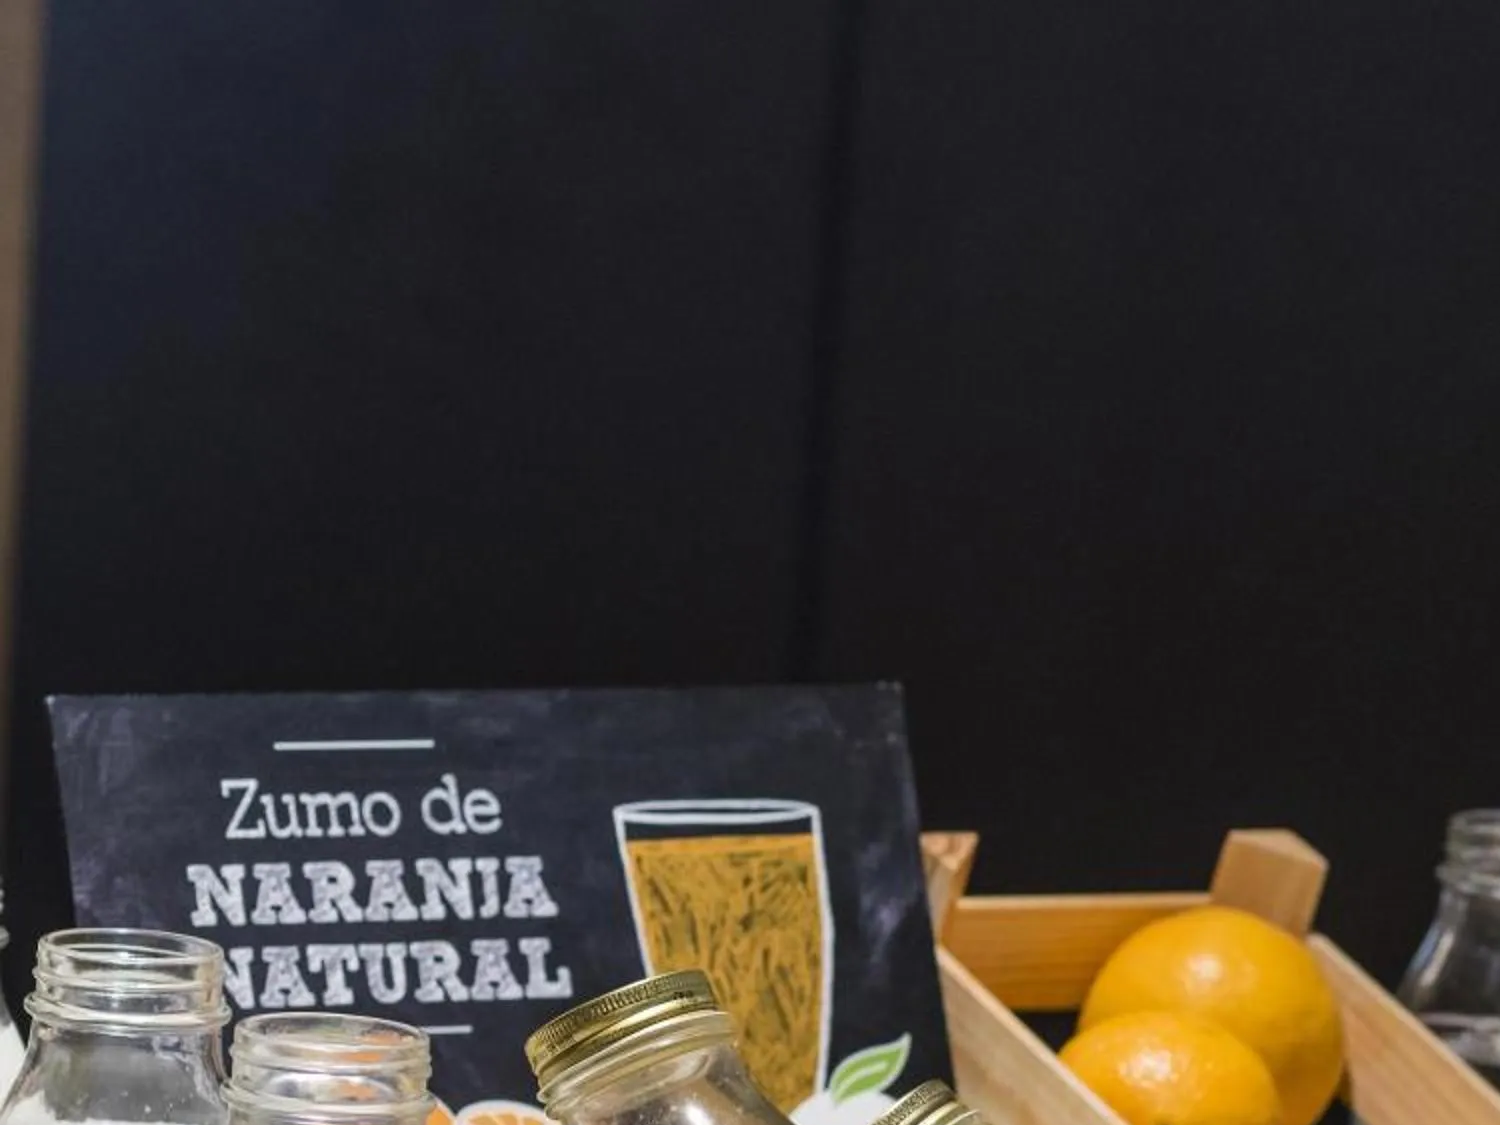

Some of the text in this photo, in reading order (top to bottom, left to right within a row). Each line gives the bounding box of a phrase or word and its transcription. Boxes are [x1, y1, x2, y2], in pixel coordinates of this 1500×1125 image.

[220, 773, 502, 838] Zumo de
[186, 856, 560, 927] NARANJA
